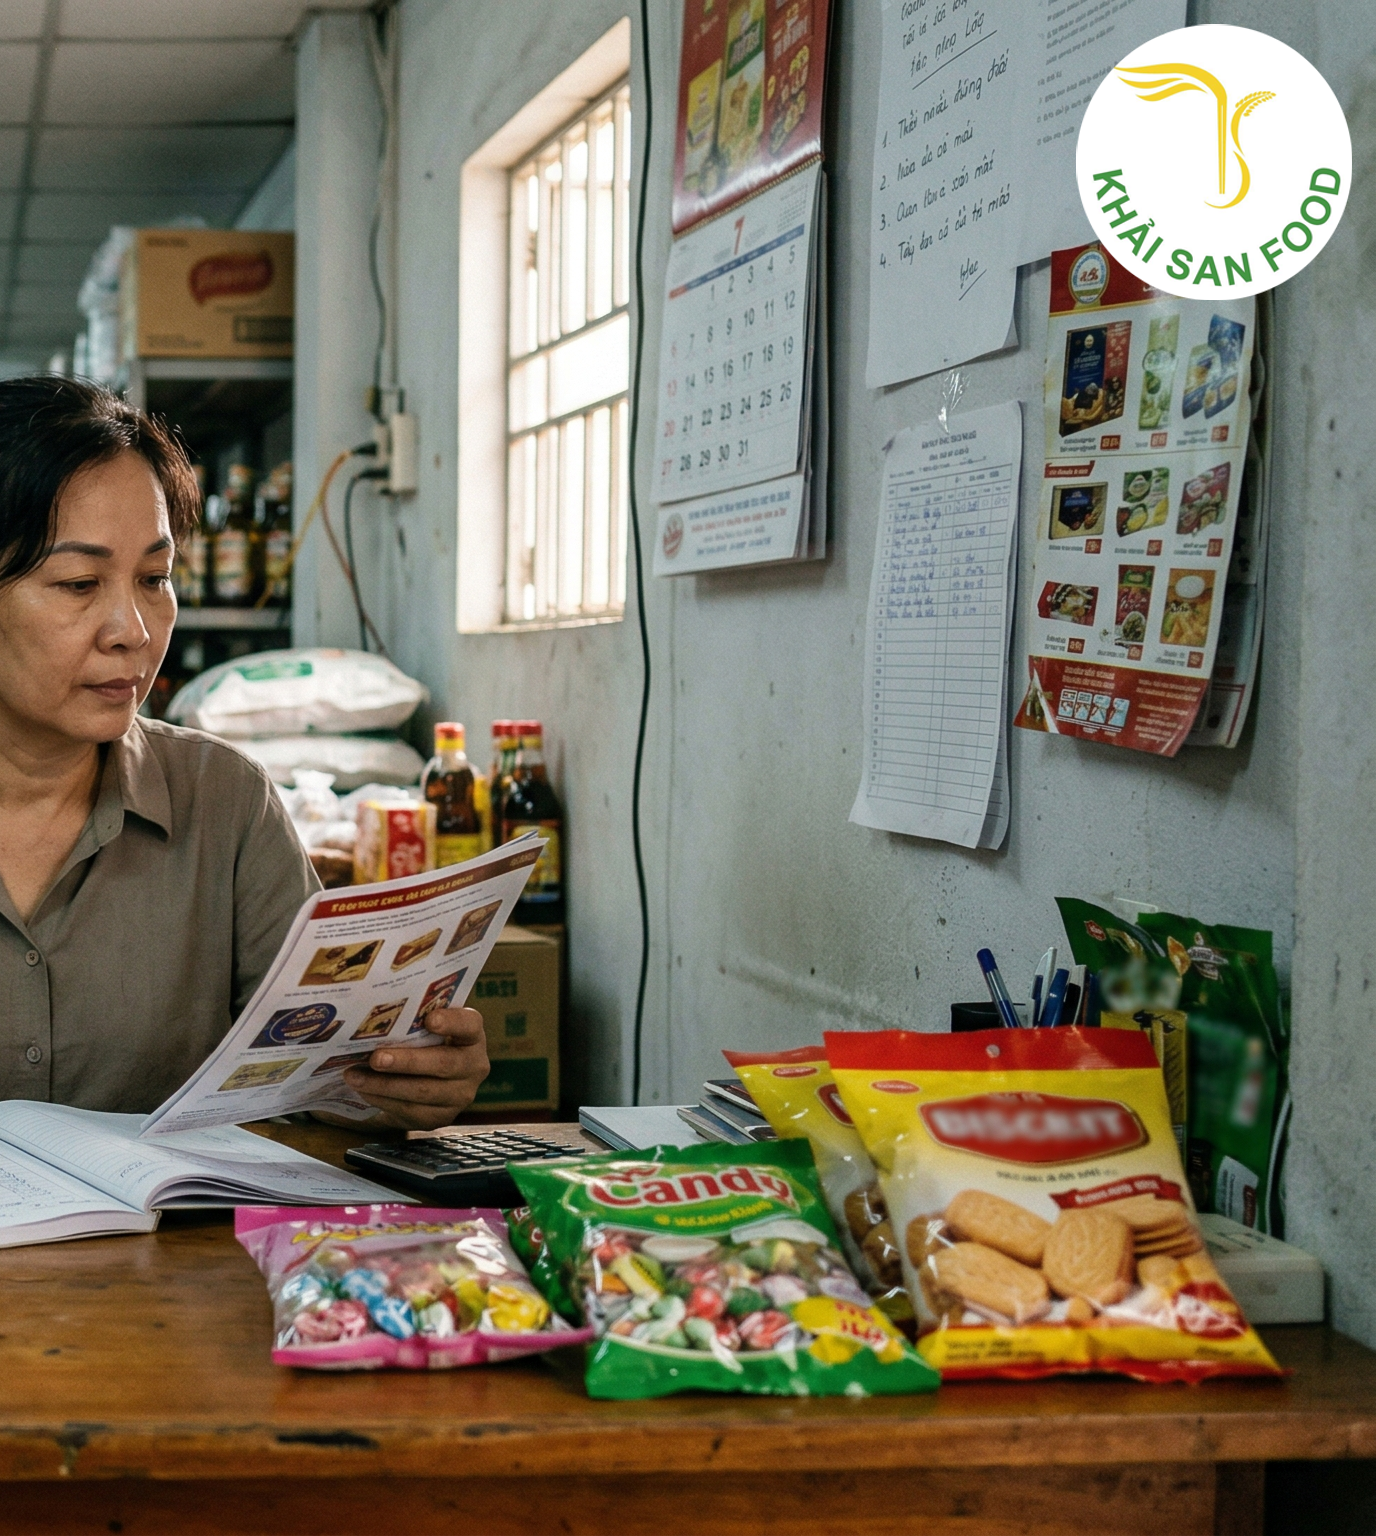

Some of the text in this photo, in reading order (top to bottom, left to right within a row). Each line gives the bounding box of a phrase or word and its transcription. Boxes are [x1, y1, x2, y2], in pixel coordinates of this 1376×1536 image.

[744, 307, 754, 328] 10
[765, 299, 774, 320] 11
[785, 290, 796, 310] 12
[704, 366, 714, 384] 15
[723, 359, 733, 378] 16
[742, 352, 753, 370] 17
[763, 344, 773, 363] 18
[783, 336, 793, 355] 19
[701, 408, 713, 426] 22
[740, 395, 751, 415] 24
[760, 389, 772, 408] 25
[780, 381, 792, 402] 26
[738, 439, 749, 458] 31
[588, 1166, 800, 1212] Candy
